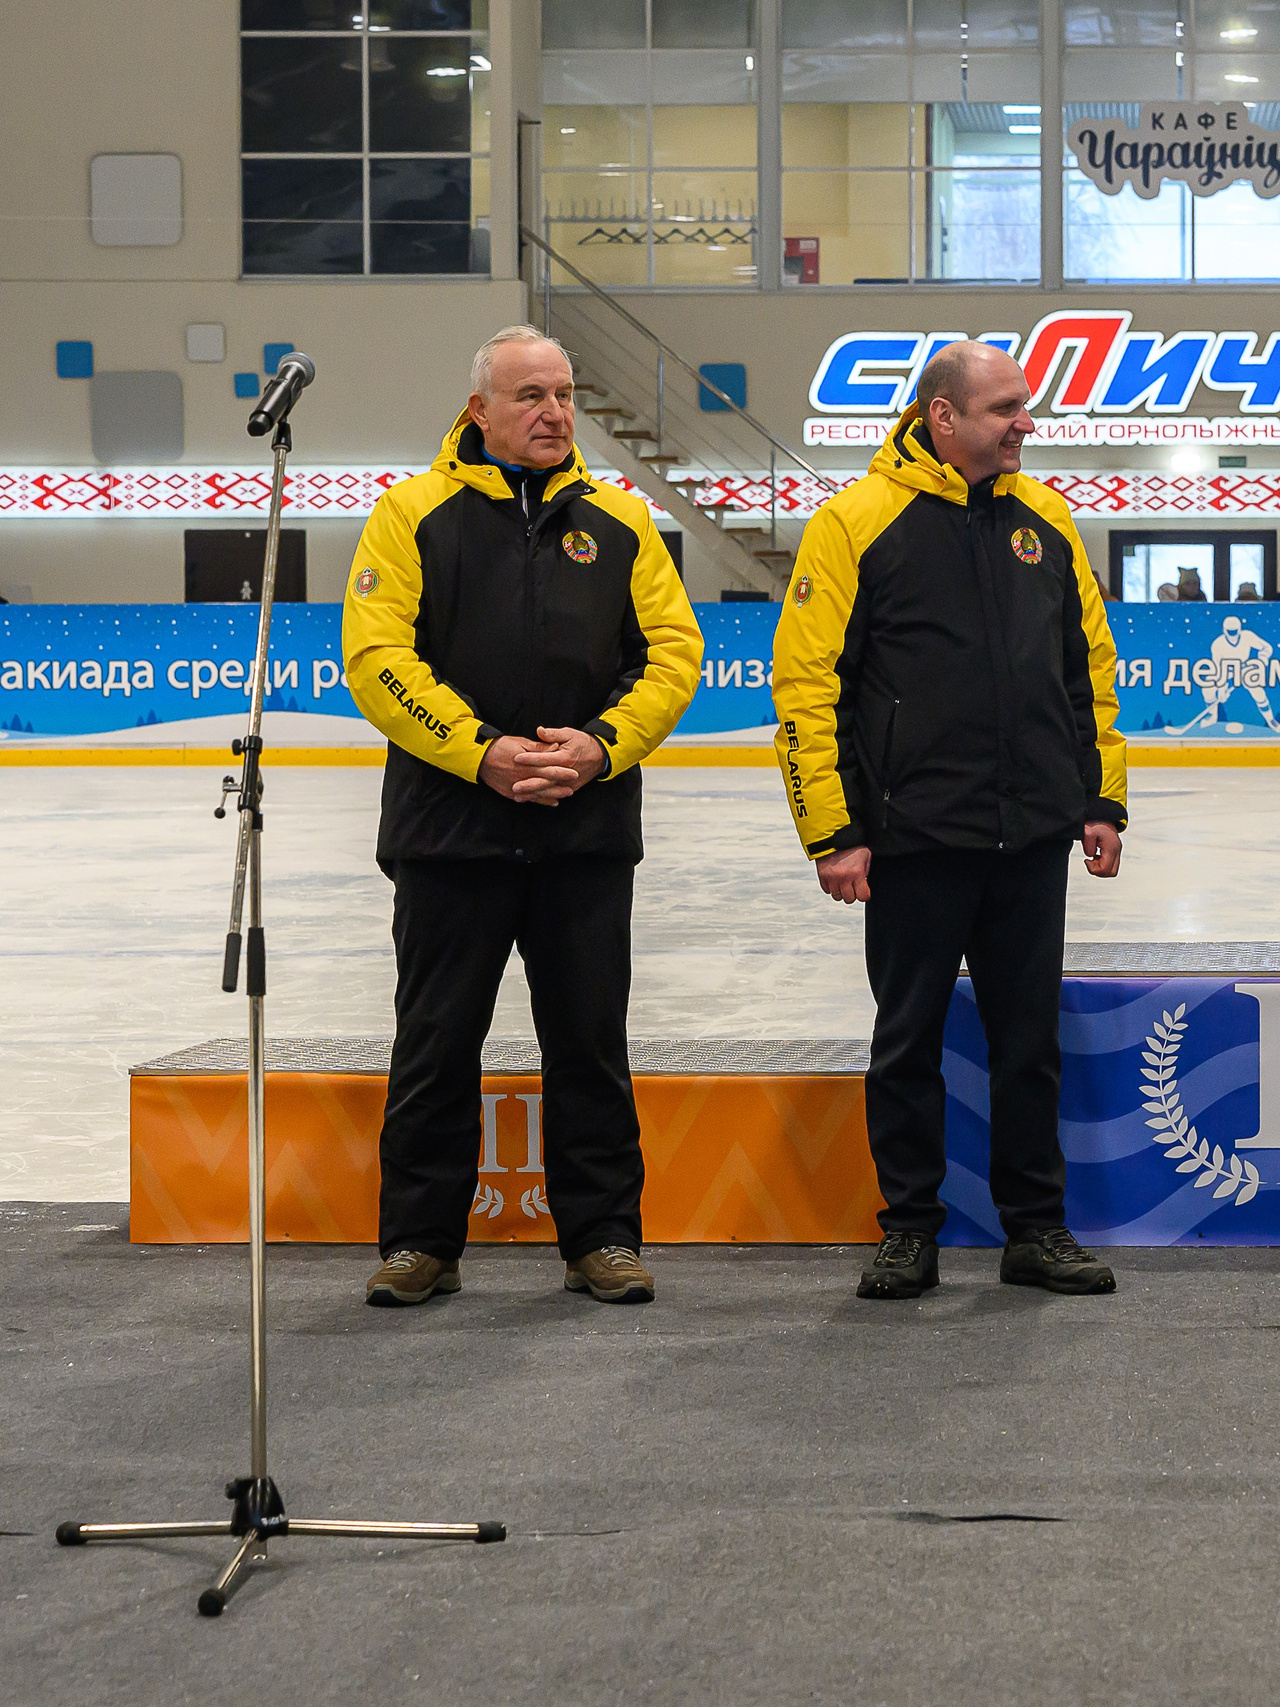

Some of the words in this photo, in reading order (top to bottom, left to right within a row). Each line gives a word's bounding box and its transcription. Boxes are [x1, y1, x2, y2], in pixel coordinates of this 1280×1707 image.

[1151, 111, 1238, 131] КАФЕ
[377, 667, 452, 741] BELARUS
[784, 720, 809, 819] BELARUS
